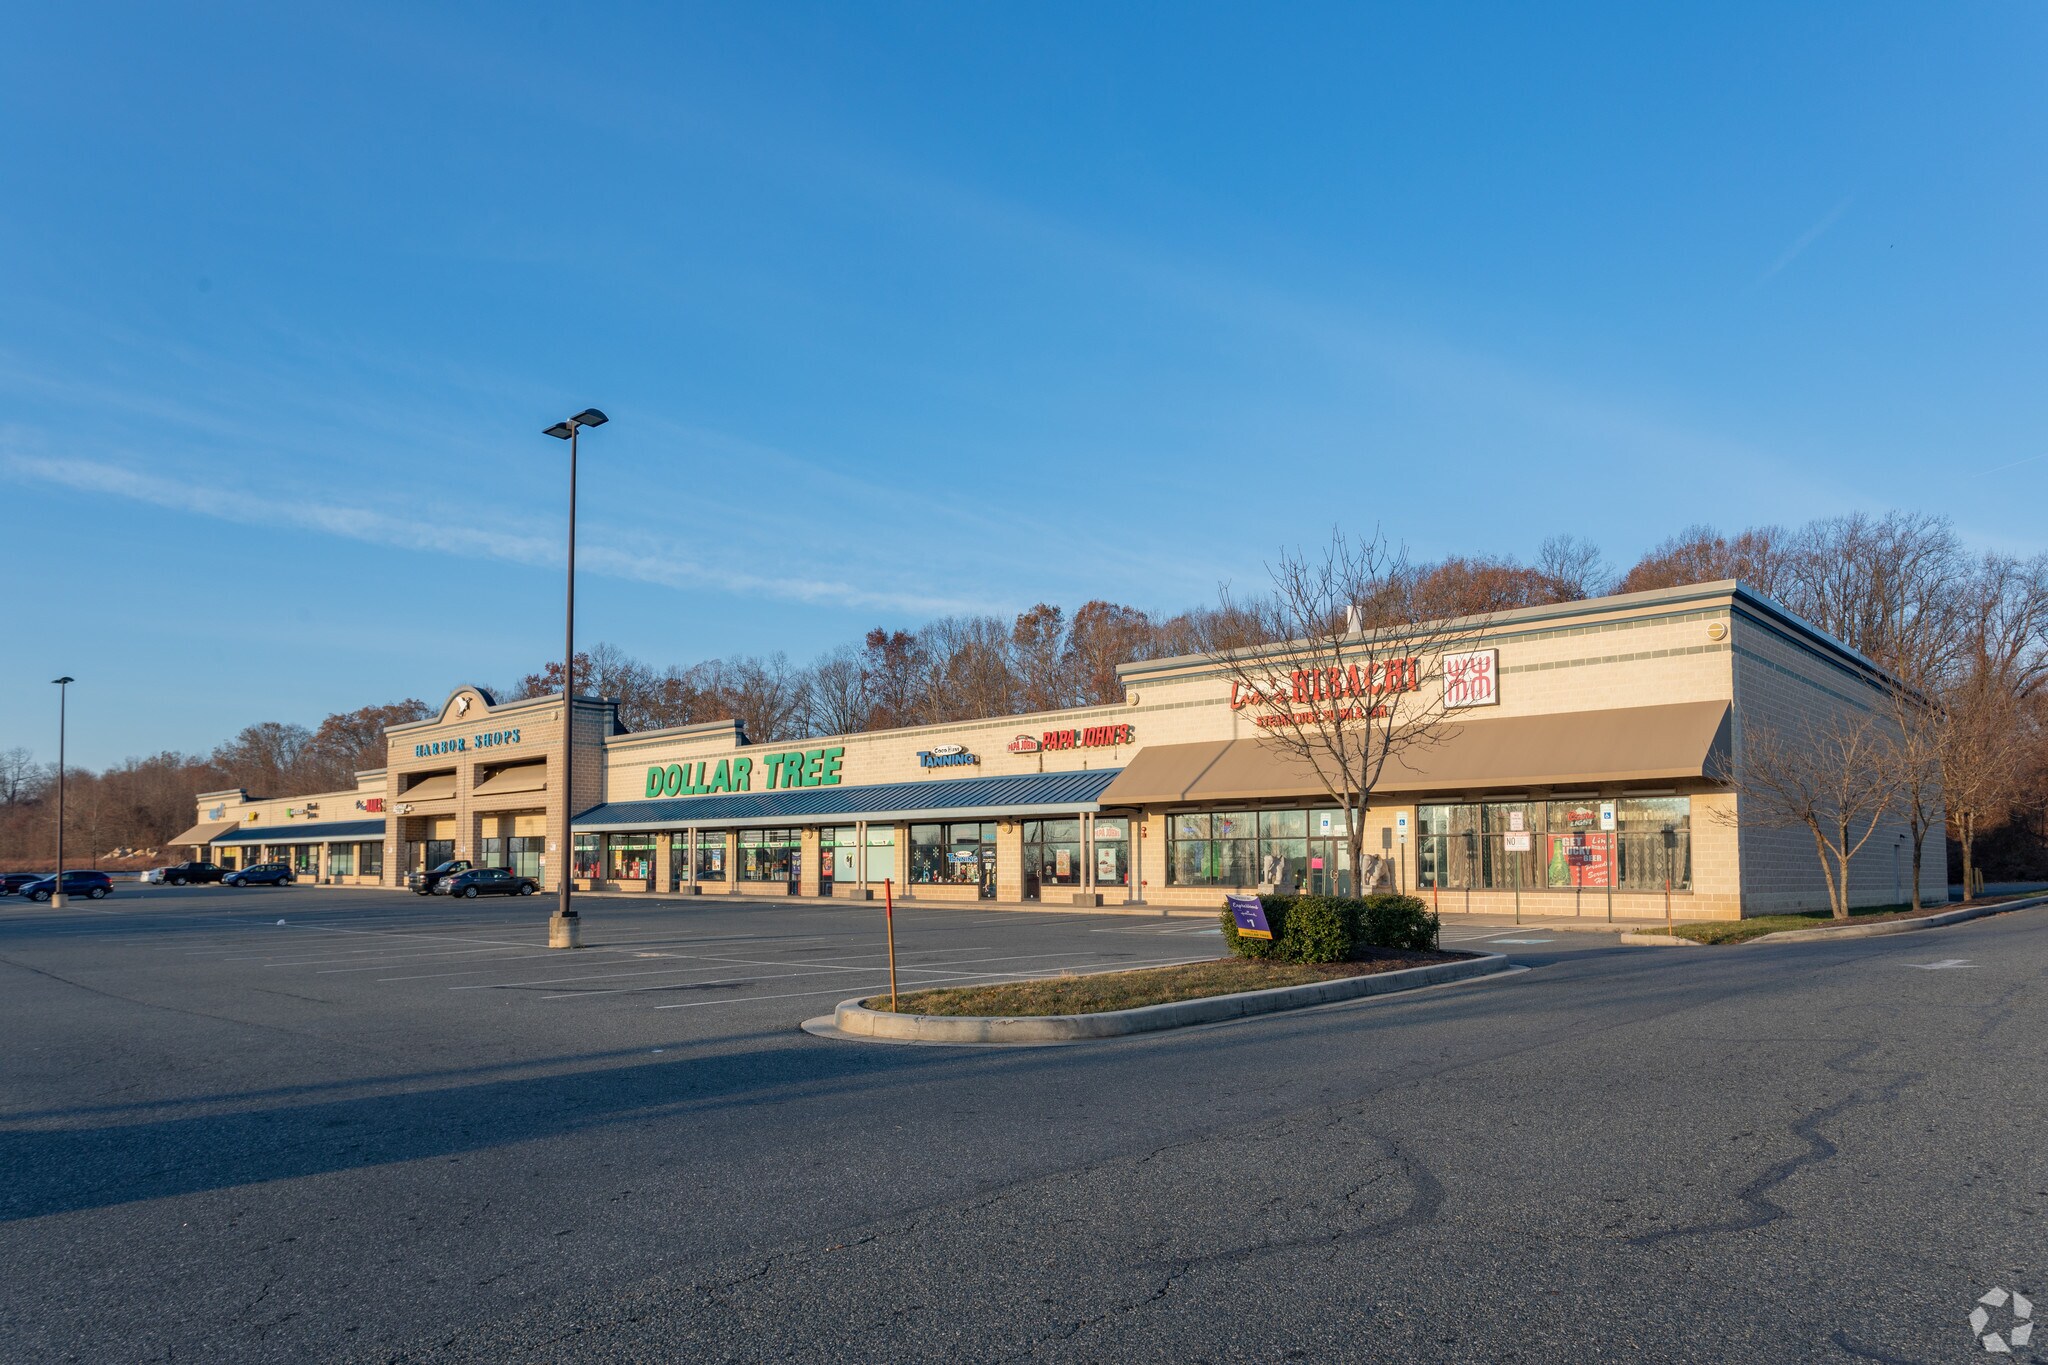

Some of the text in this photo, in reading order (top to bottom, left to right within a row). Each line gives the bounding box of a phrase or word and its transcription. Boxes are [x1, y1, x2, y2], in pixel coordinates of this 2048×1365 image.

[1292, 657, 1418, 703] HIBACHI
[415, 728, 521, 757] HARBOR SHOPS
[1042, 723, 1129, 751] PAPA JOHN'S
[1008, 743, 1020, 751] PAPA
[916, 751, 975, 768] TANNING
[645, 746, 845, 798] DOLLAR TREE
[1506, 837, 1516, 846] NO
[1562, 837, 1583, 846] GET
[1563, 846, 1591, 855] LUCKY
[1583, 854, 1602, 862] BEER
